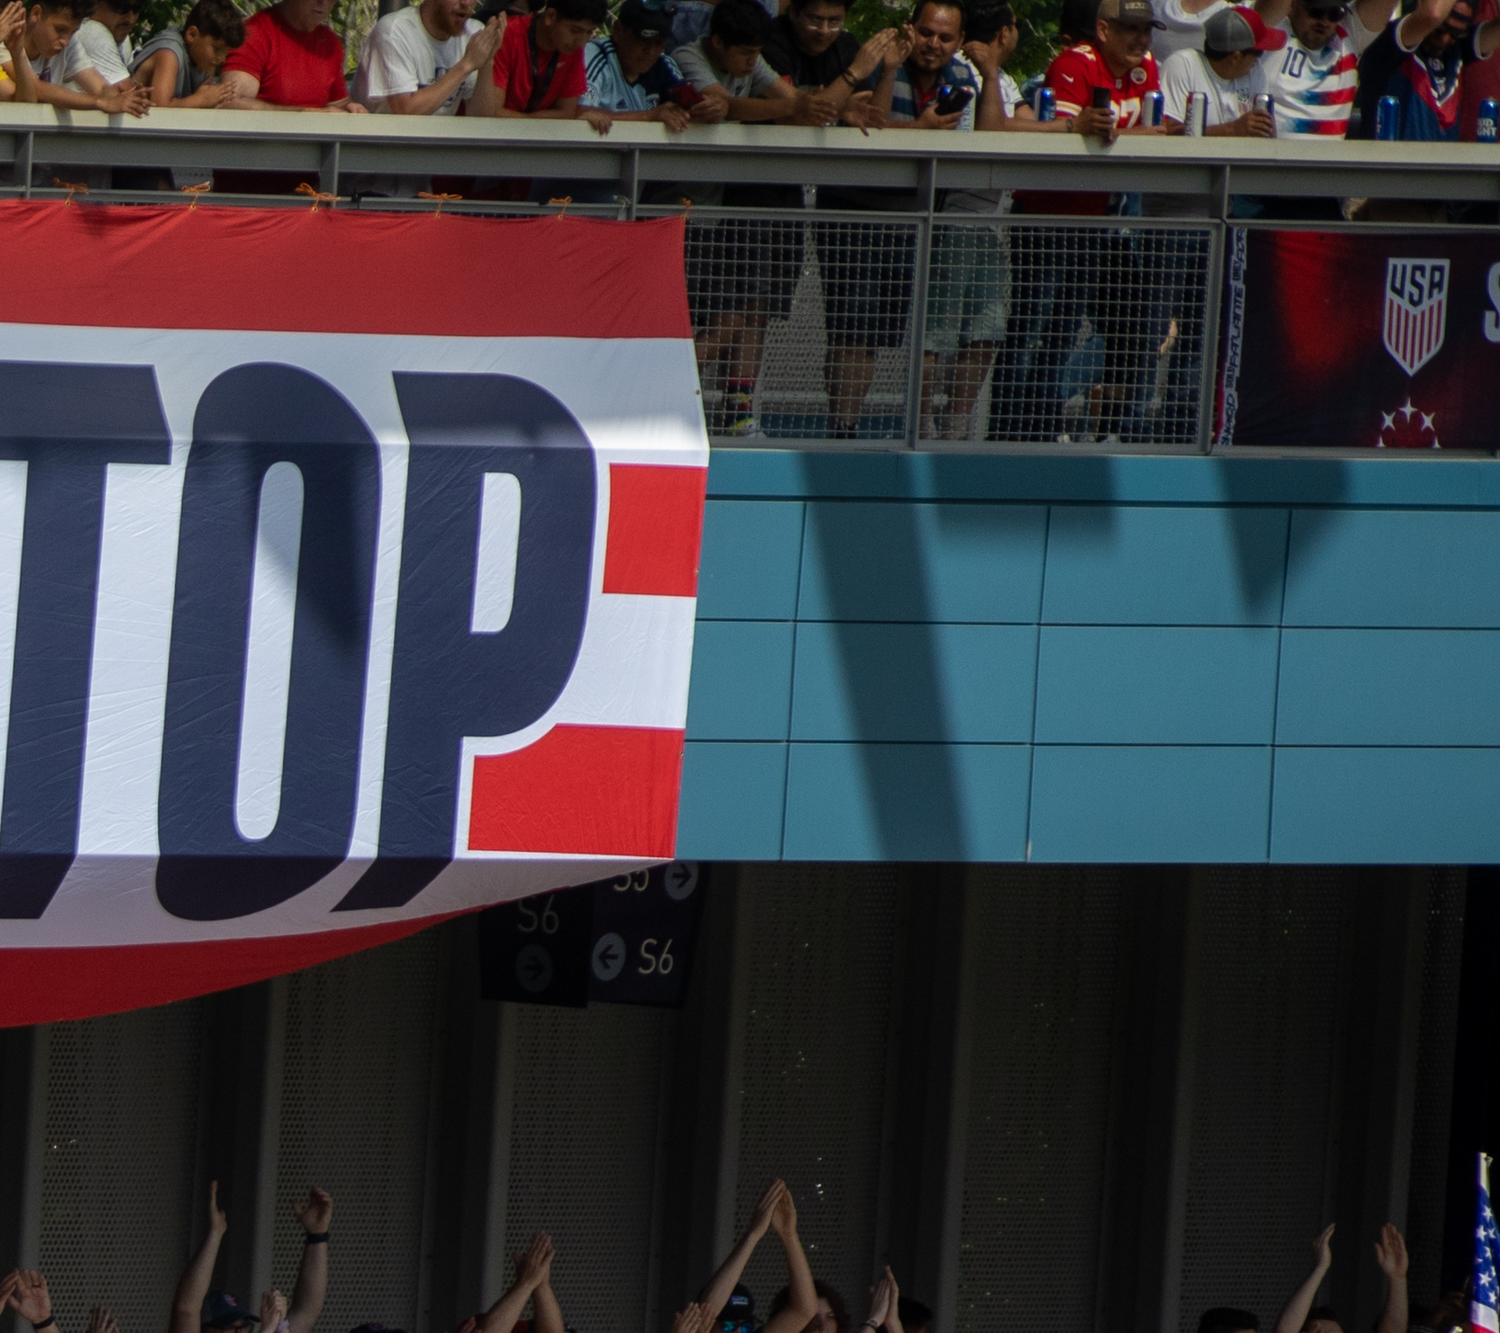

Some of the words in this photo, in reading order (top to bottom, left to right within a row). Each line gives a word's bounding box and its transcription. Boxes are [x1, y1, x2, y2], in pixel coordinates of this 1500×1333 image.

[1280, 46, 1307, 77] 10
[1390, 264, 1446, 307] USA
[638, 938, 674, 975] S6
